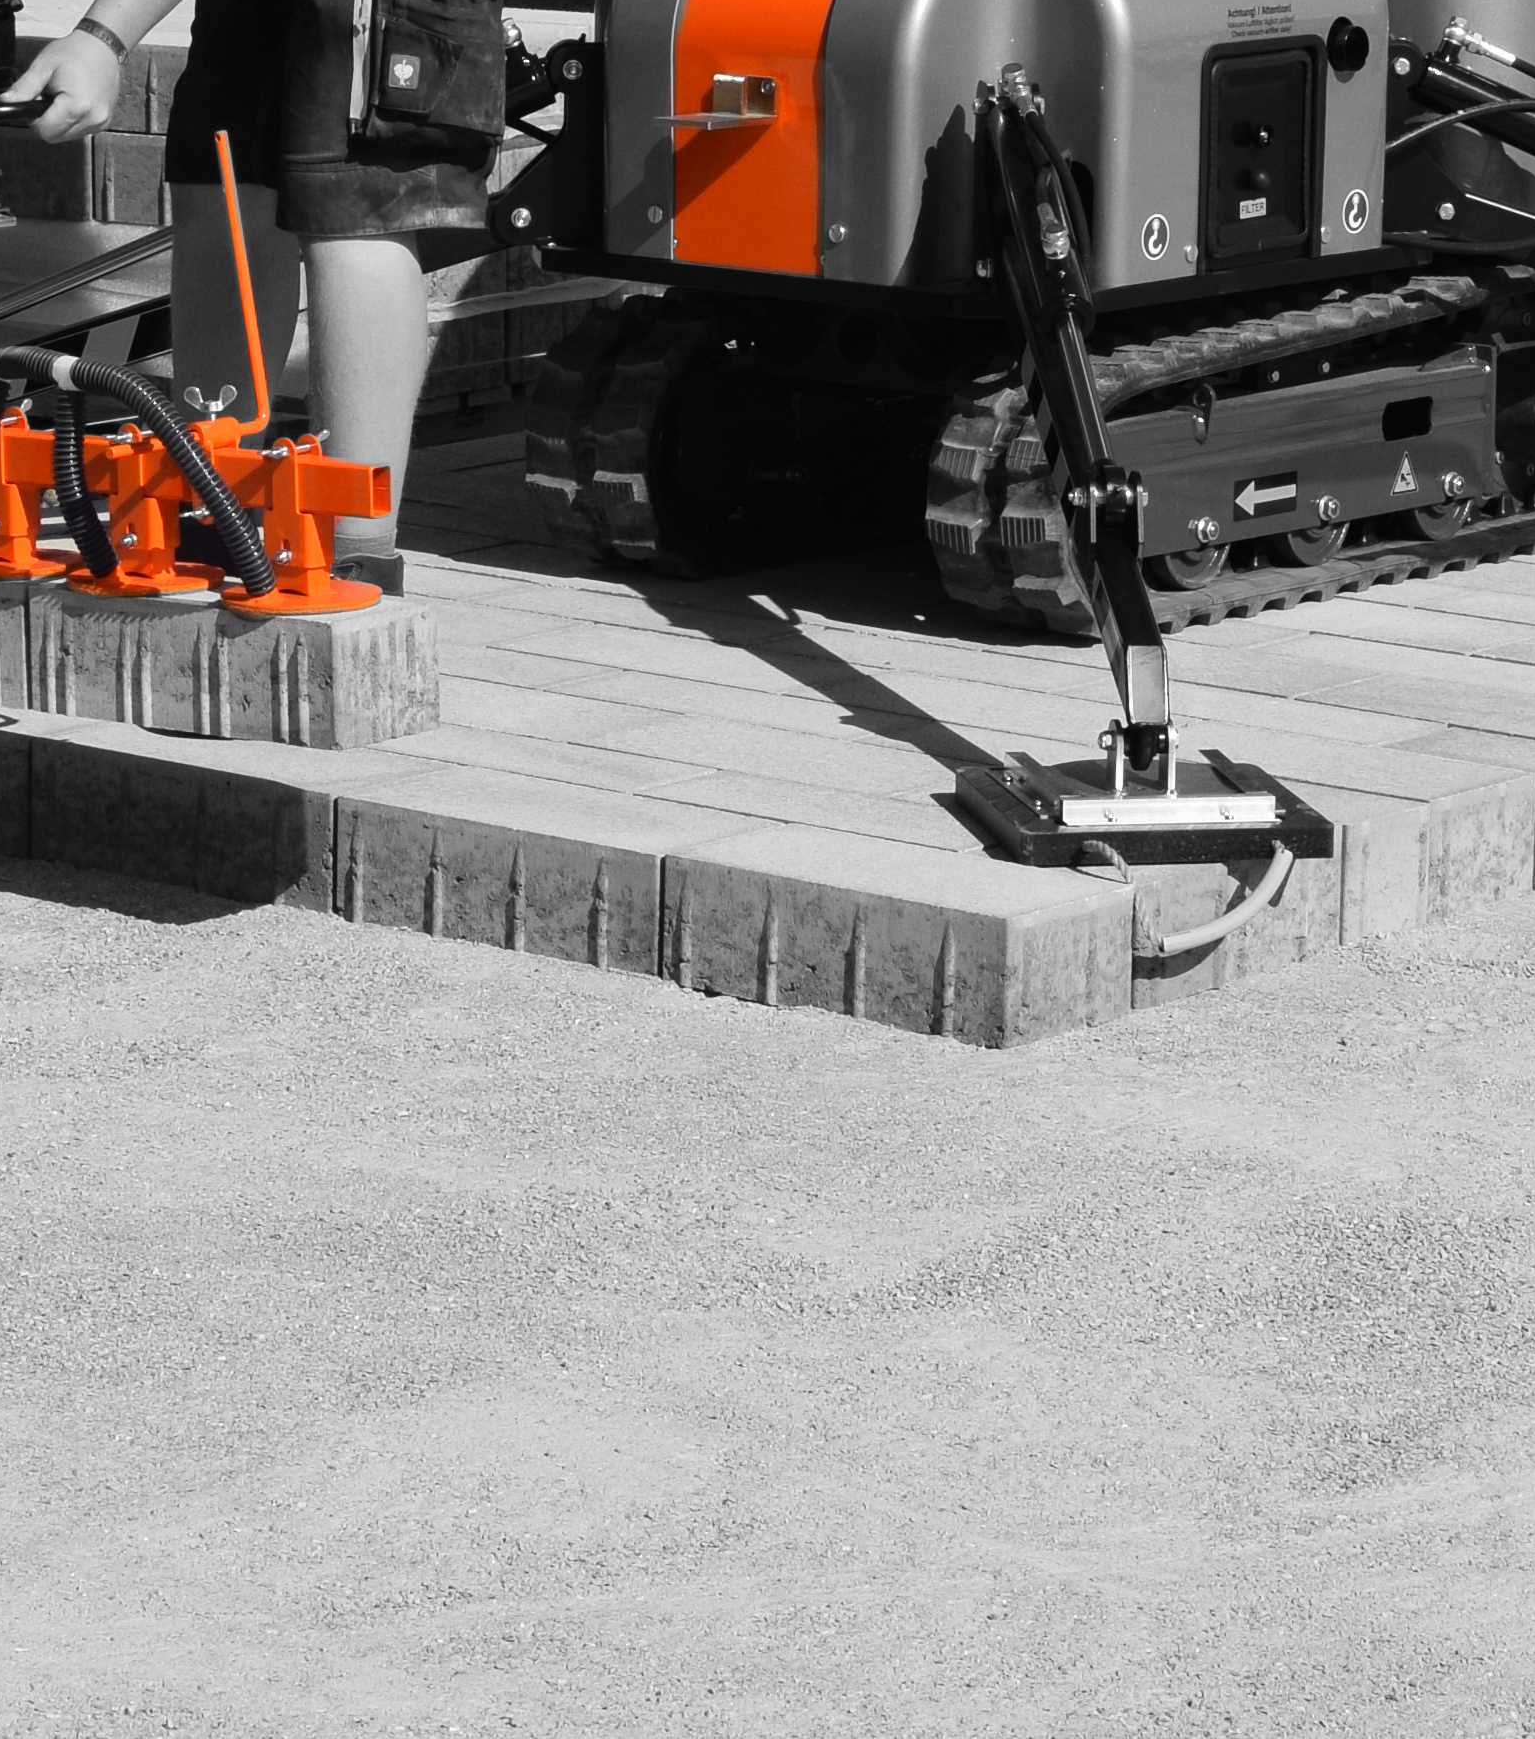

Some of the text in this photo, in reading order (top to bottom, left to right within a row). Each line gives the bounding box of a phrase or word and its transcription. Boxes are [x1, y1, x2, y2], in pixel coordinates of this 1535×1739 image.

[1228, 3, 1292, 18] Achtung! Attention!
[1242, 202, 1264, 213] FILTER
